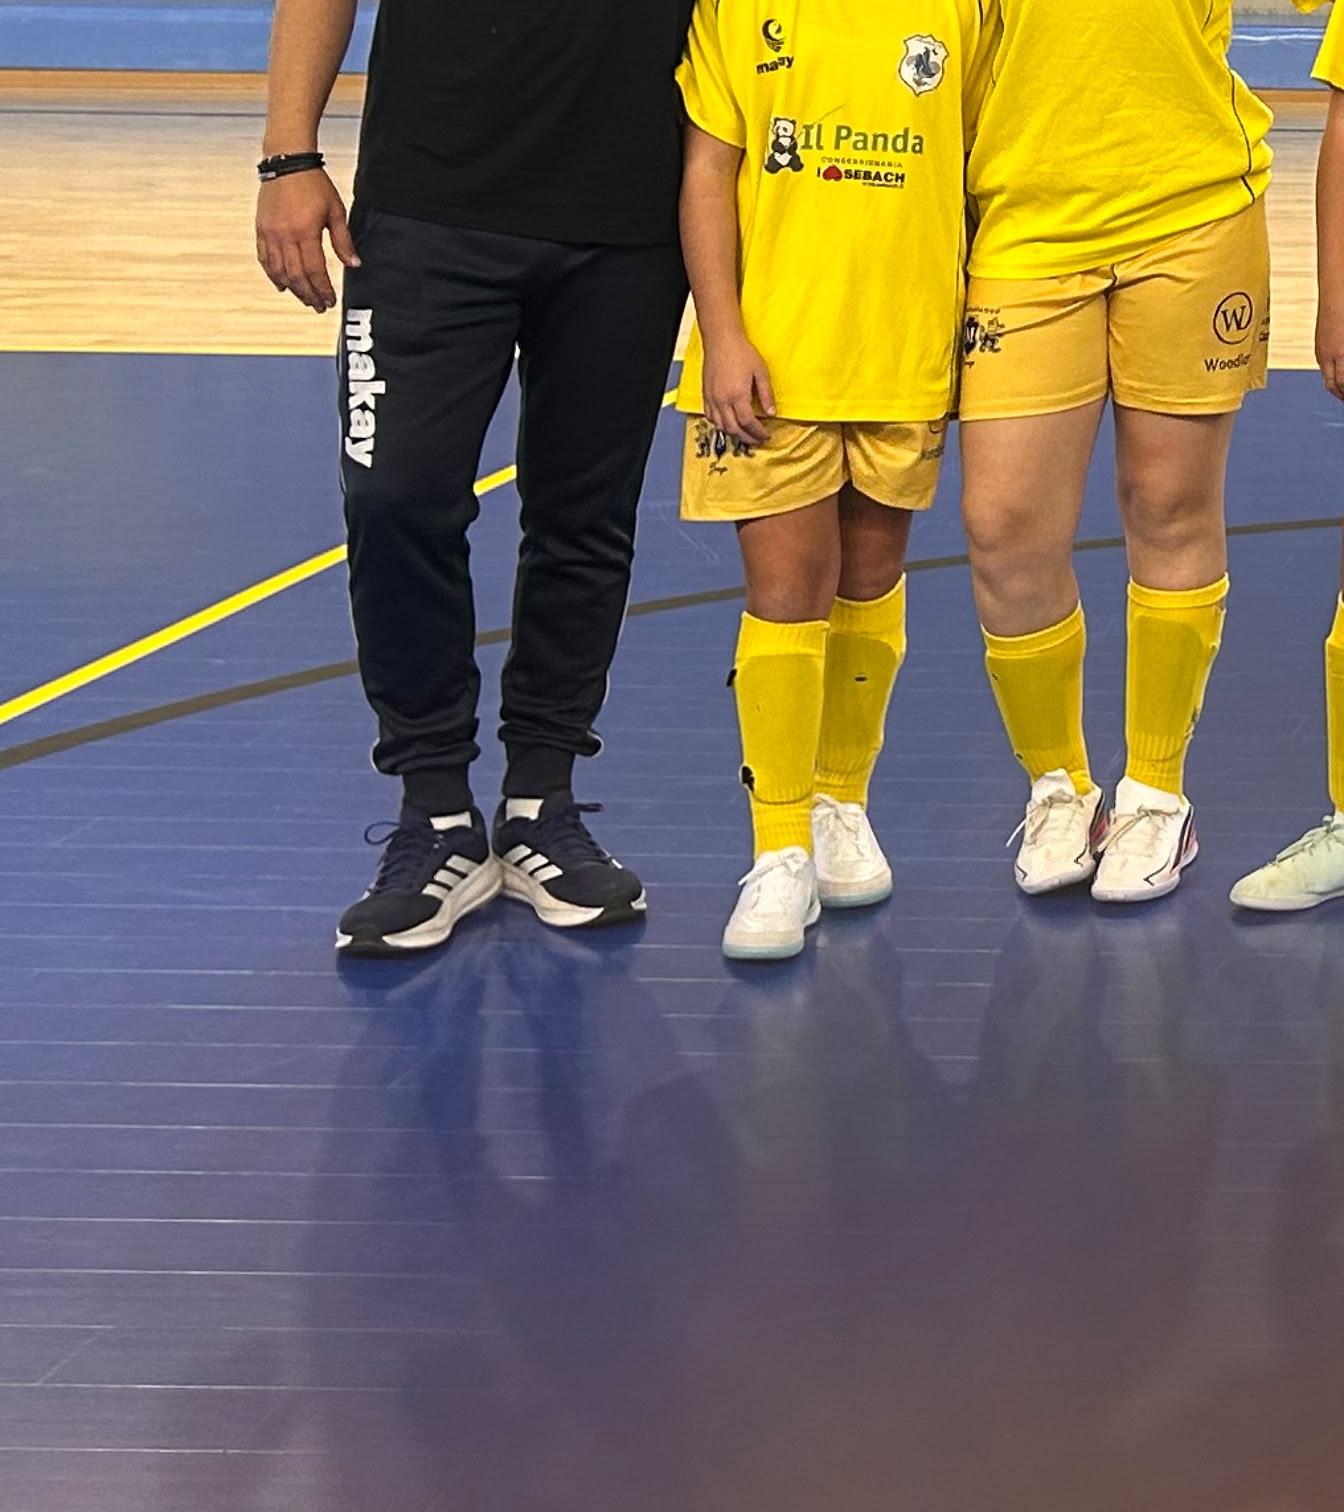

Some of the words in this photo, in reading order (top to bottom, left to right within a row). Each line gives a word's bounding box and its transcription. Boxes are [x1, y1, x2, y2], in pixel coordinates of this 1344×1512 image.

[801, 123, 824, 151] Il
[834, 125, 924, 155] Panda
[843, 169, 905, 184] SEBACH
[345, 307, 386, 468] makay
